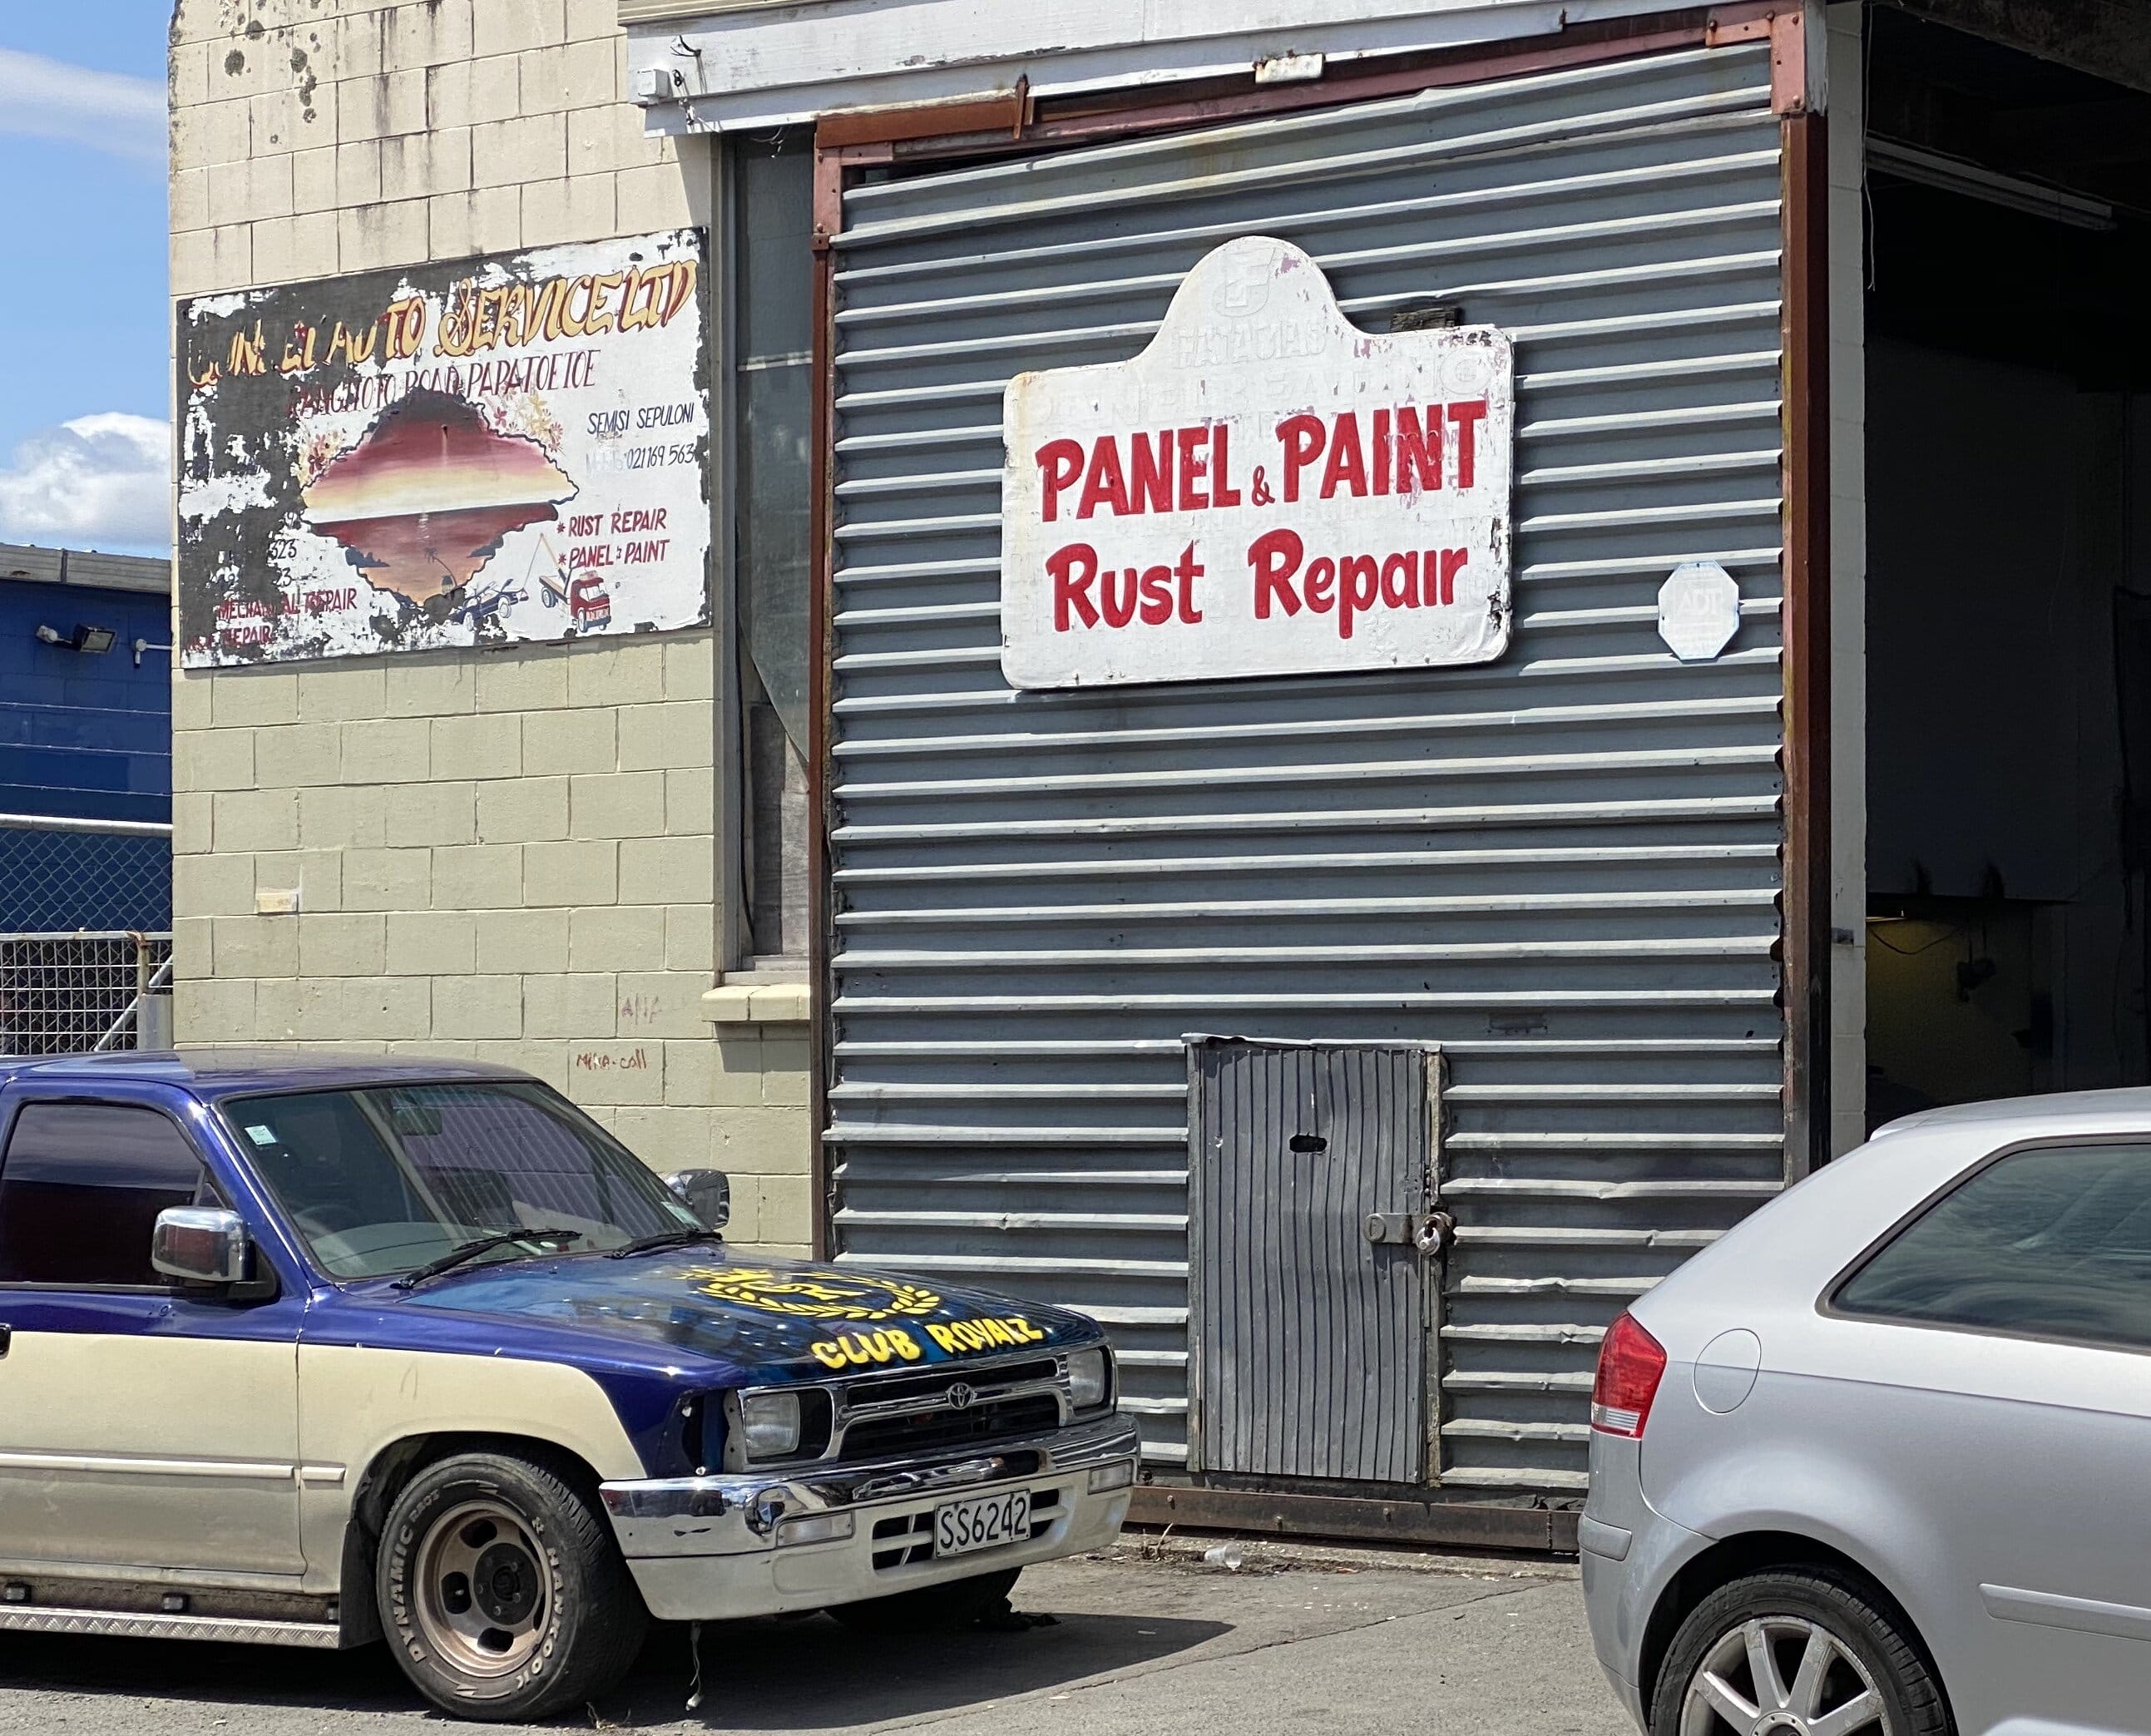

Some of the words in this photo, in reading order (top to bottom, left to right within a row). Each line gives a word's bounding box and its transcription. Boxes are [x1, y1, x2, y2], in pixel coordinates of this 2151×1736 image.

[433, 277, 622, 358] SERVICE
[617, 259, 697, 333] LTD
[466, 349, 601, 398] PAPATOETOE
[586, 409, 630, 437] SEMISI
[636, 403, 695, 429] SEPULONI
[1034, 423, 1241, 522] PANEL
[1251, 464, 1276, 507] &
[1275, 399, 1487, 503] PAINT
[568, 514, 604, 537] RUST
[611, 507, 666, 534] REPAIR
[569, 544, 614, 569] PANEL
[624, 538, 670, 564] PAINT
[1045, 539, 1205, 632] Rust
[1248, 528, 1469, 640] Repair
[810, 1329, 922, 1369] CLUB
[940, 1494, 1027, 1549] SS6242
